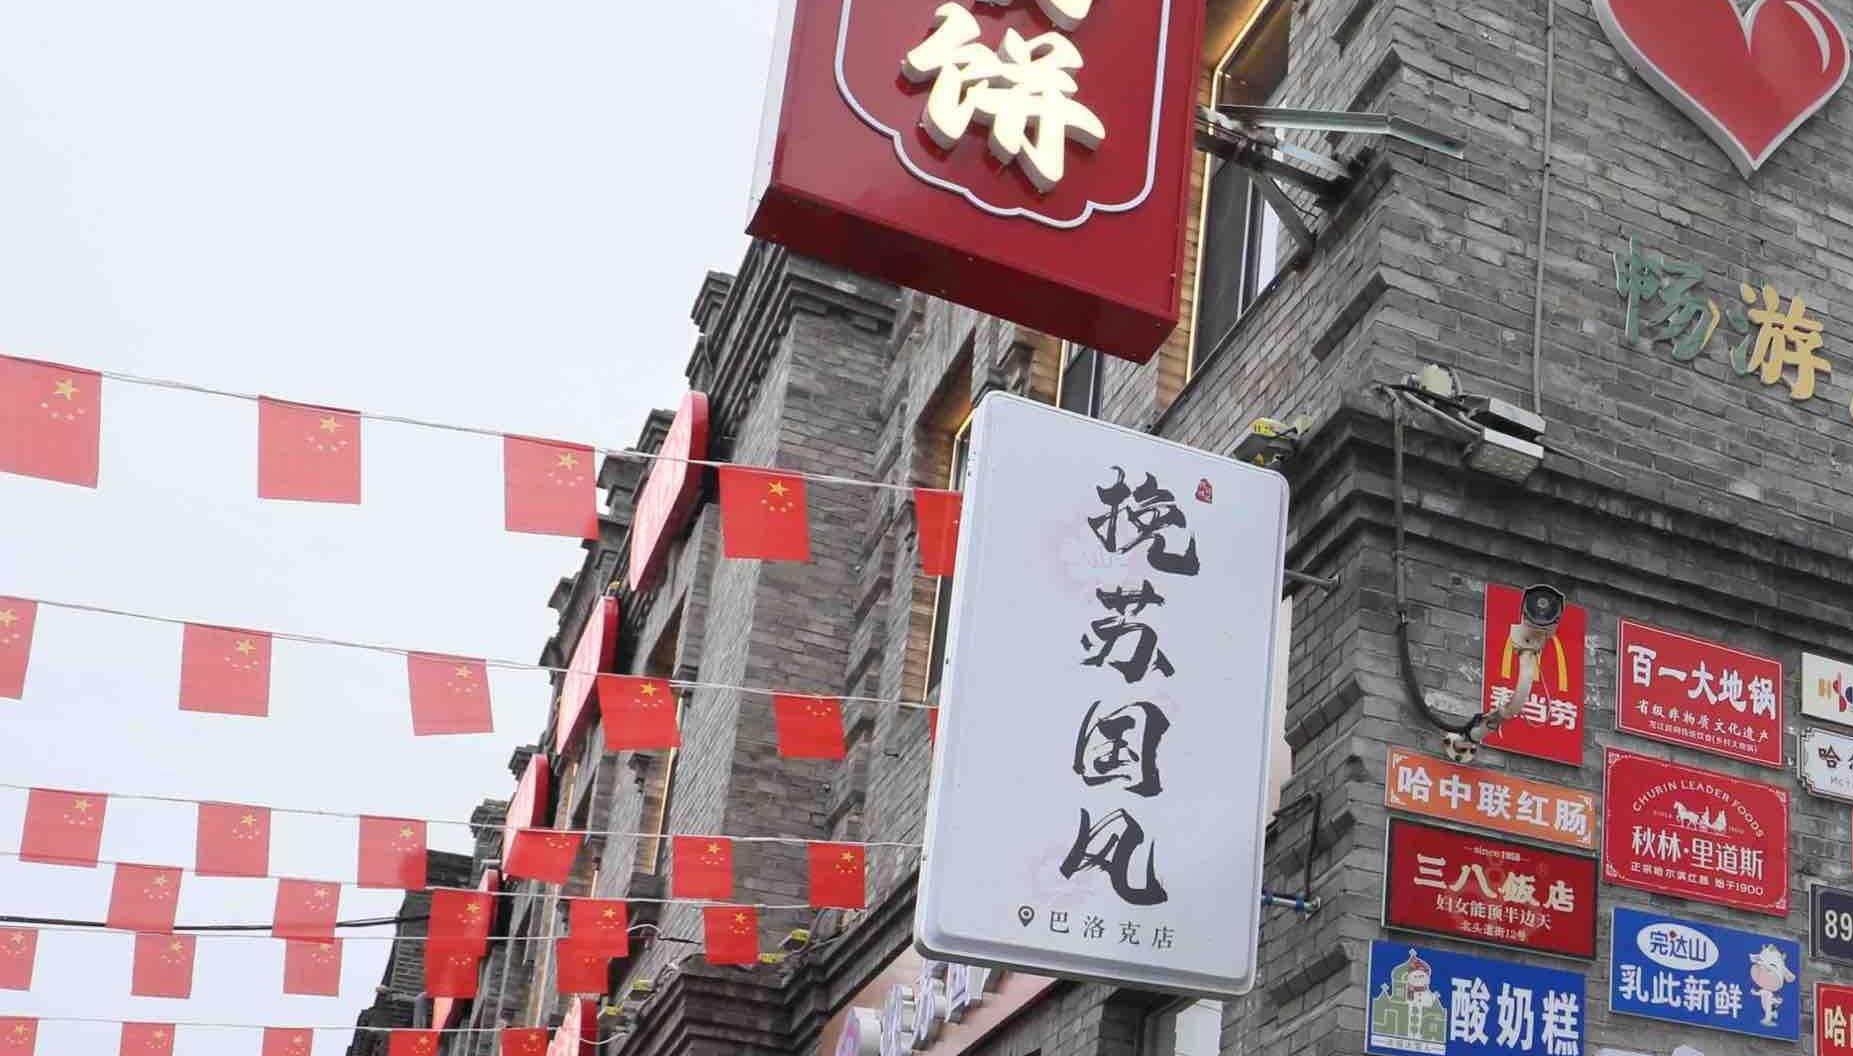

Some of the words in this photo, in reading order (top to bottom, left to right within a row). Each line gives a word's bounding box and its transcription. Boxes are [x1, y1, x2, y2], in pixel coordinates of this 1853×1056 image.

[1627, 644, 1776, 719] 百一大地锅
[1399, 767, 1589, 837] 哈中联红肠
[1632, 780, 1677, 812] CHURIN
[1680, 779, 1730, 803] LEADER
[1732, 800, 1764, 838] FOODS
[1049, 909, 1175, 951] 巴洛克店
[1435, 894, 1551, 930] 妇女能顶半边天
[1649, 929, 1708, 963] 完达山
[1451, 976, 1579, 1056] 酸奶糕
[1620, 964, 1743, 1019] 乳此新鲜
